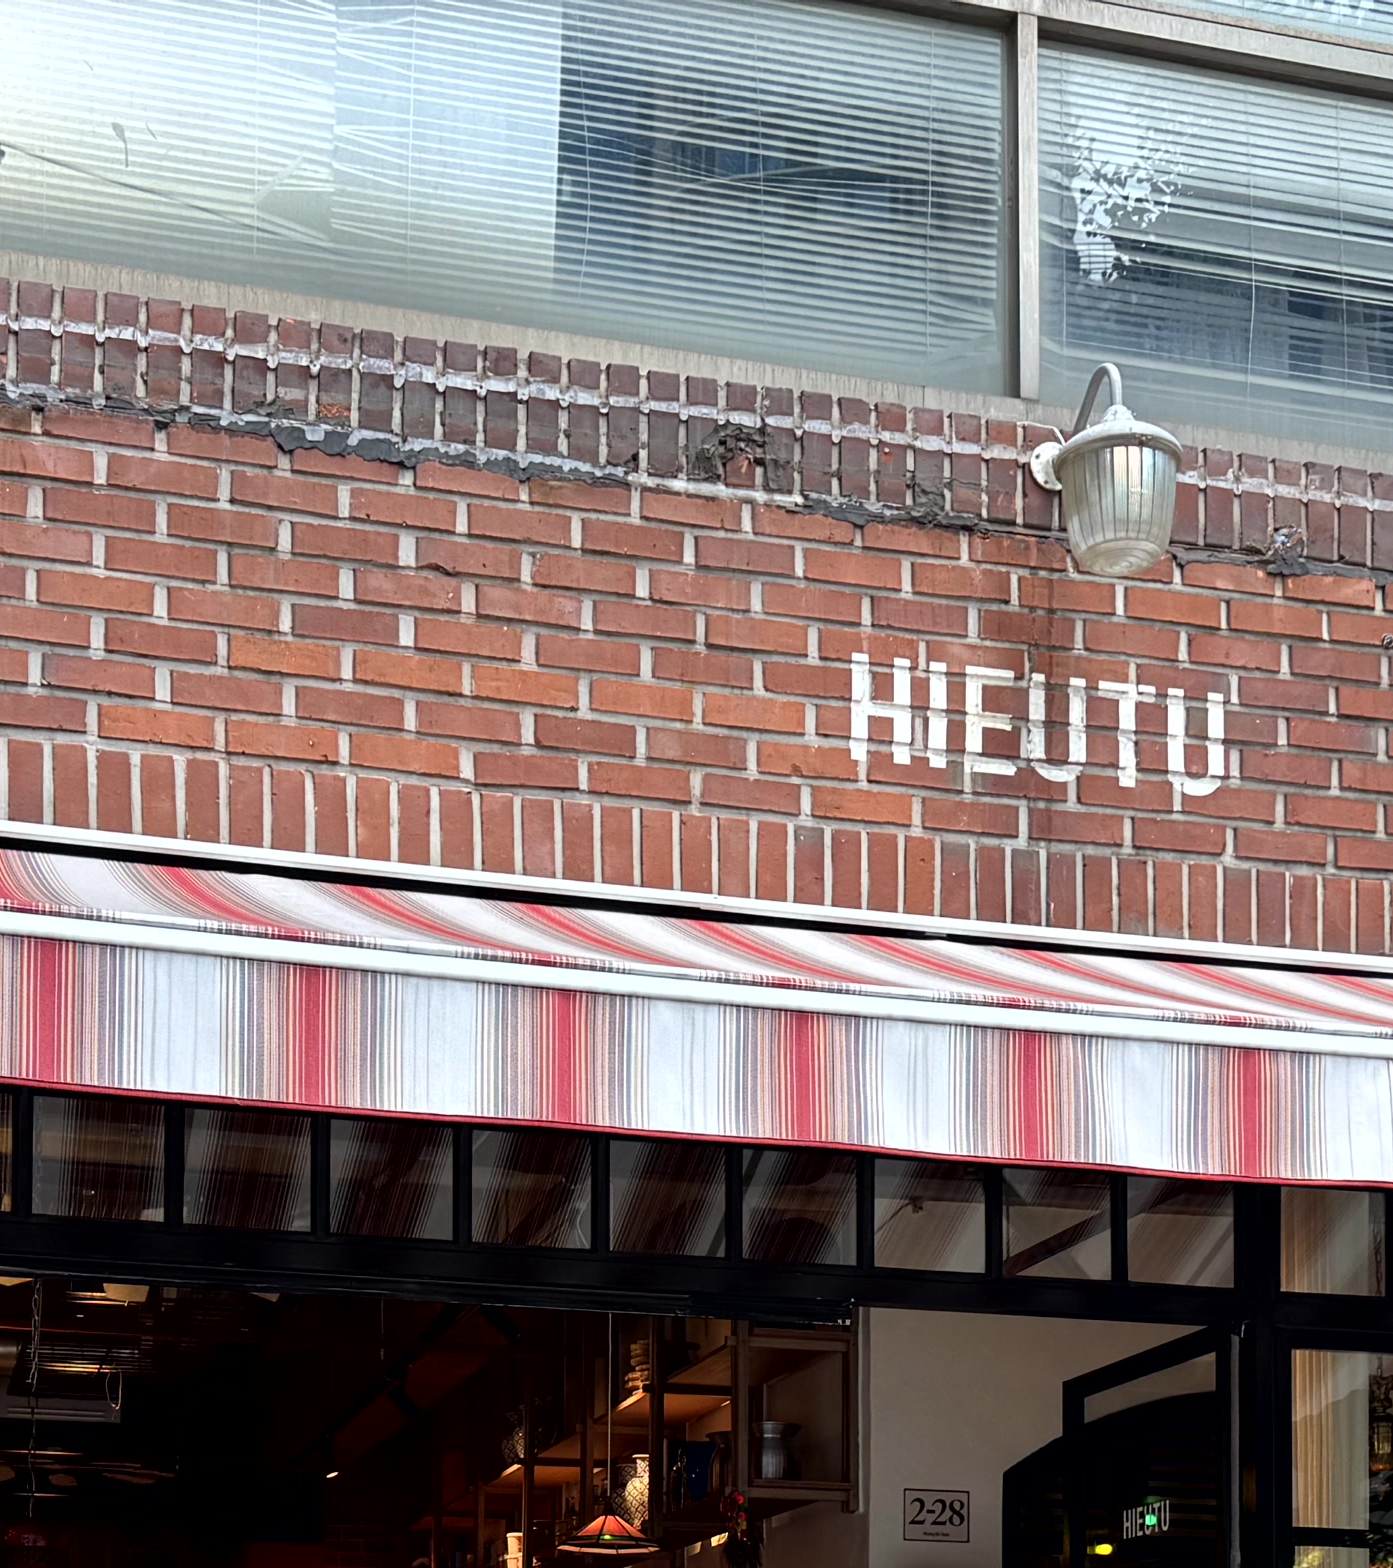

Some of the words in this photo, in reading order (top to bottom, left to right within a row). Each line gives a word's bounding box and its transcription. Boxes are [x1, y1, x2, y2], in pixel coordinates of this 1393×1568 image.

[848, 651, 1225, 797] HIEUTU
[908, 1497, 966, 1527] 2-28
[1122, 1499, 1170, 1540] HIEUTU
